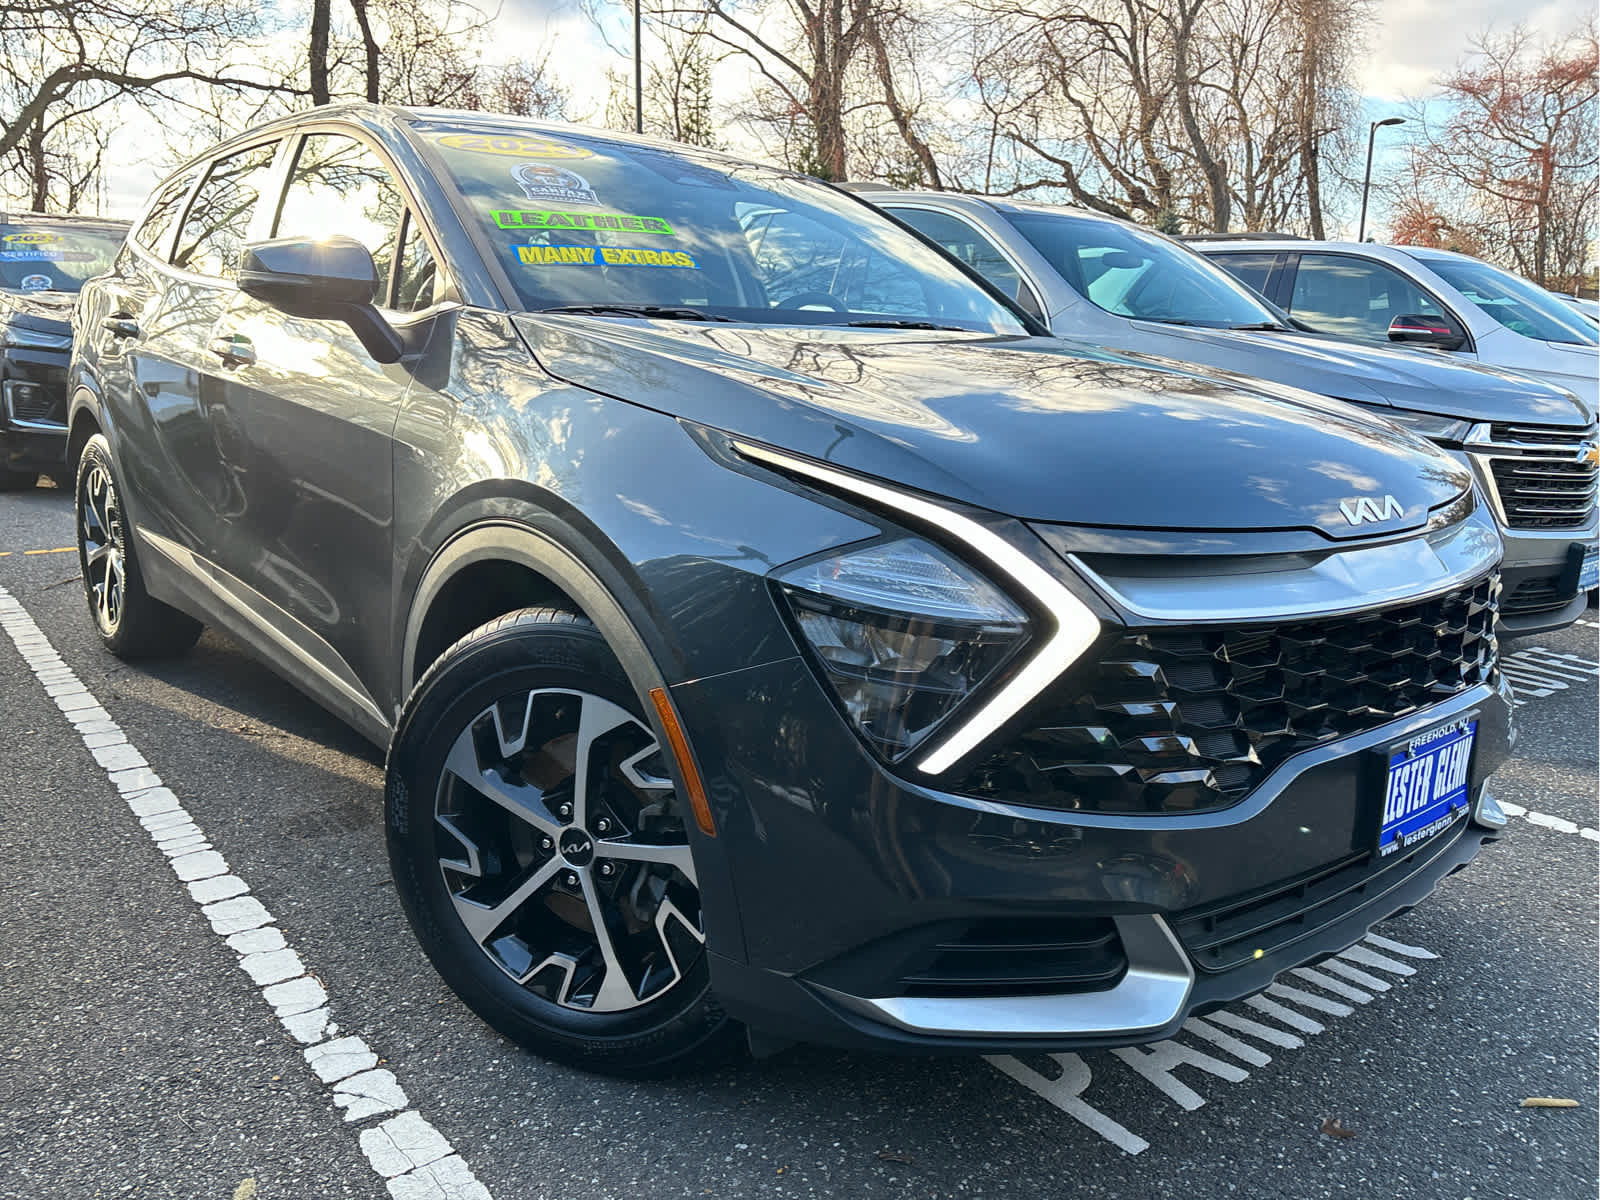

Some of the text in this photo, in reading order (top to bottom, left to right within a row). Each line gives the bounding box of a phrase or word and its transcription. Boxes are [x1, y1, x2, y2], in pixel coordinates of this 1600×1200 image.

[499, 212, 668, 232] LEATHER
[518, 246, 596, 264] MANY
[1339, 495, 1404, 525] KIA
[1383, 735, 1473, 825] LESTER GLENN
